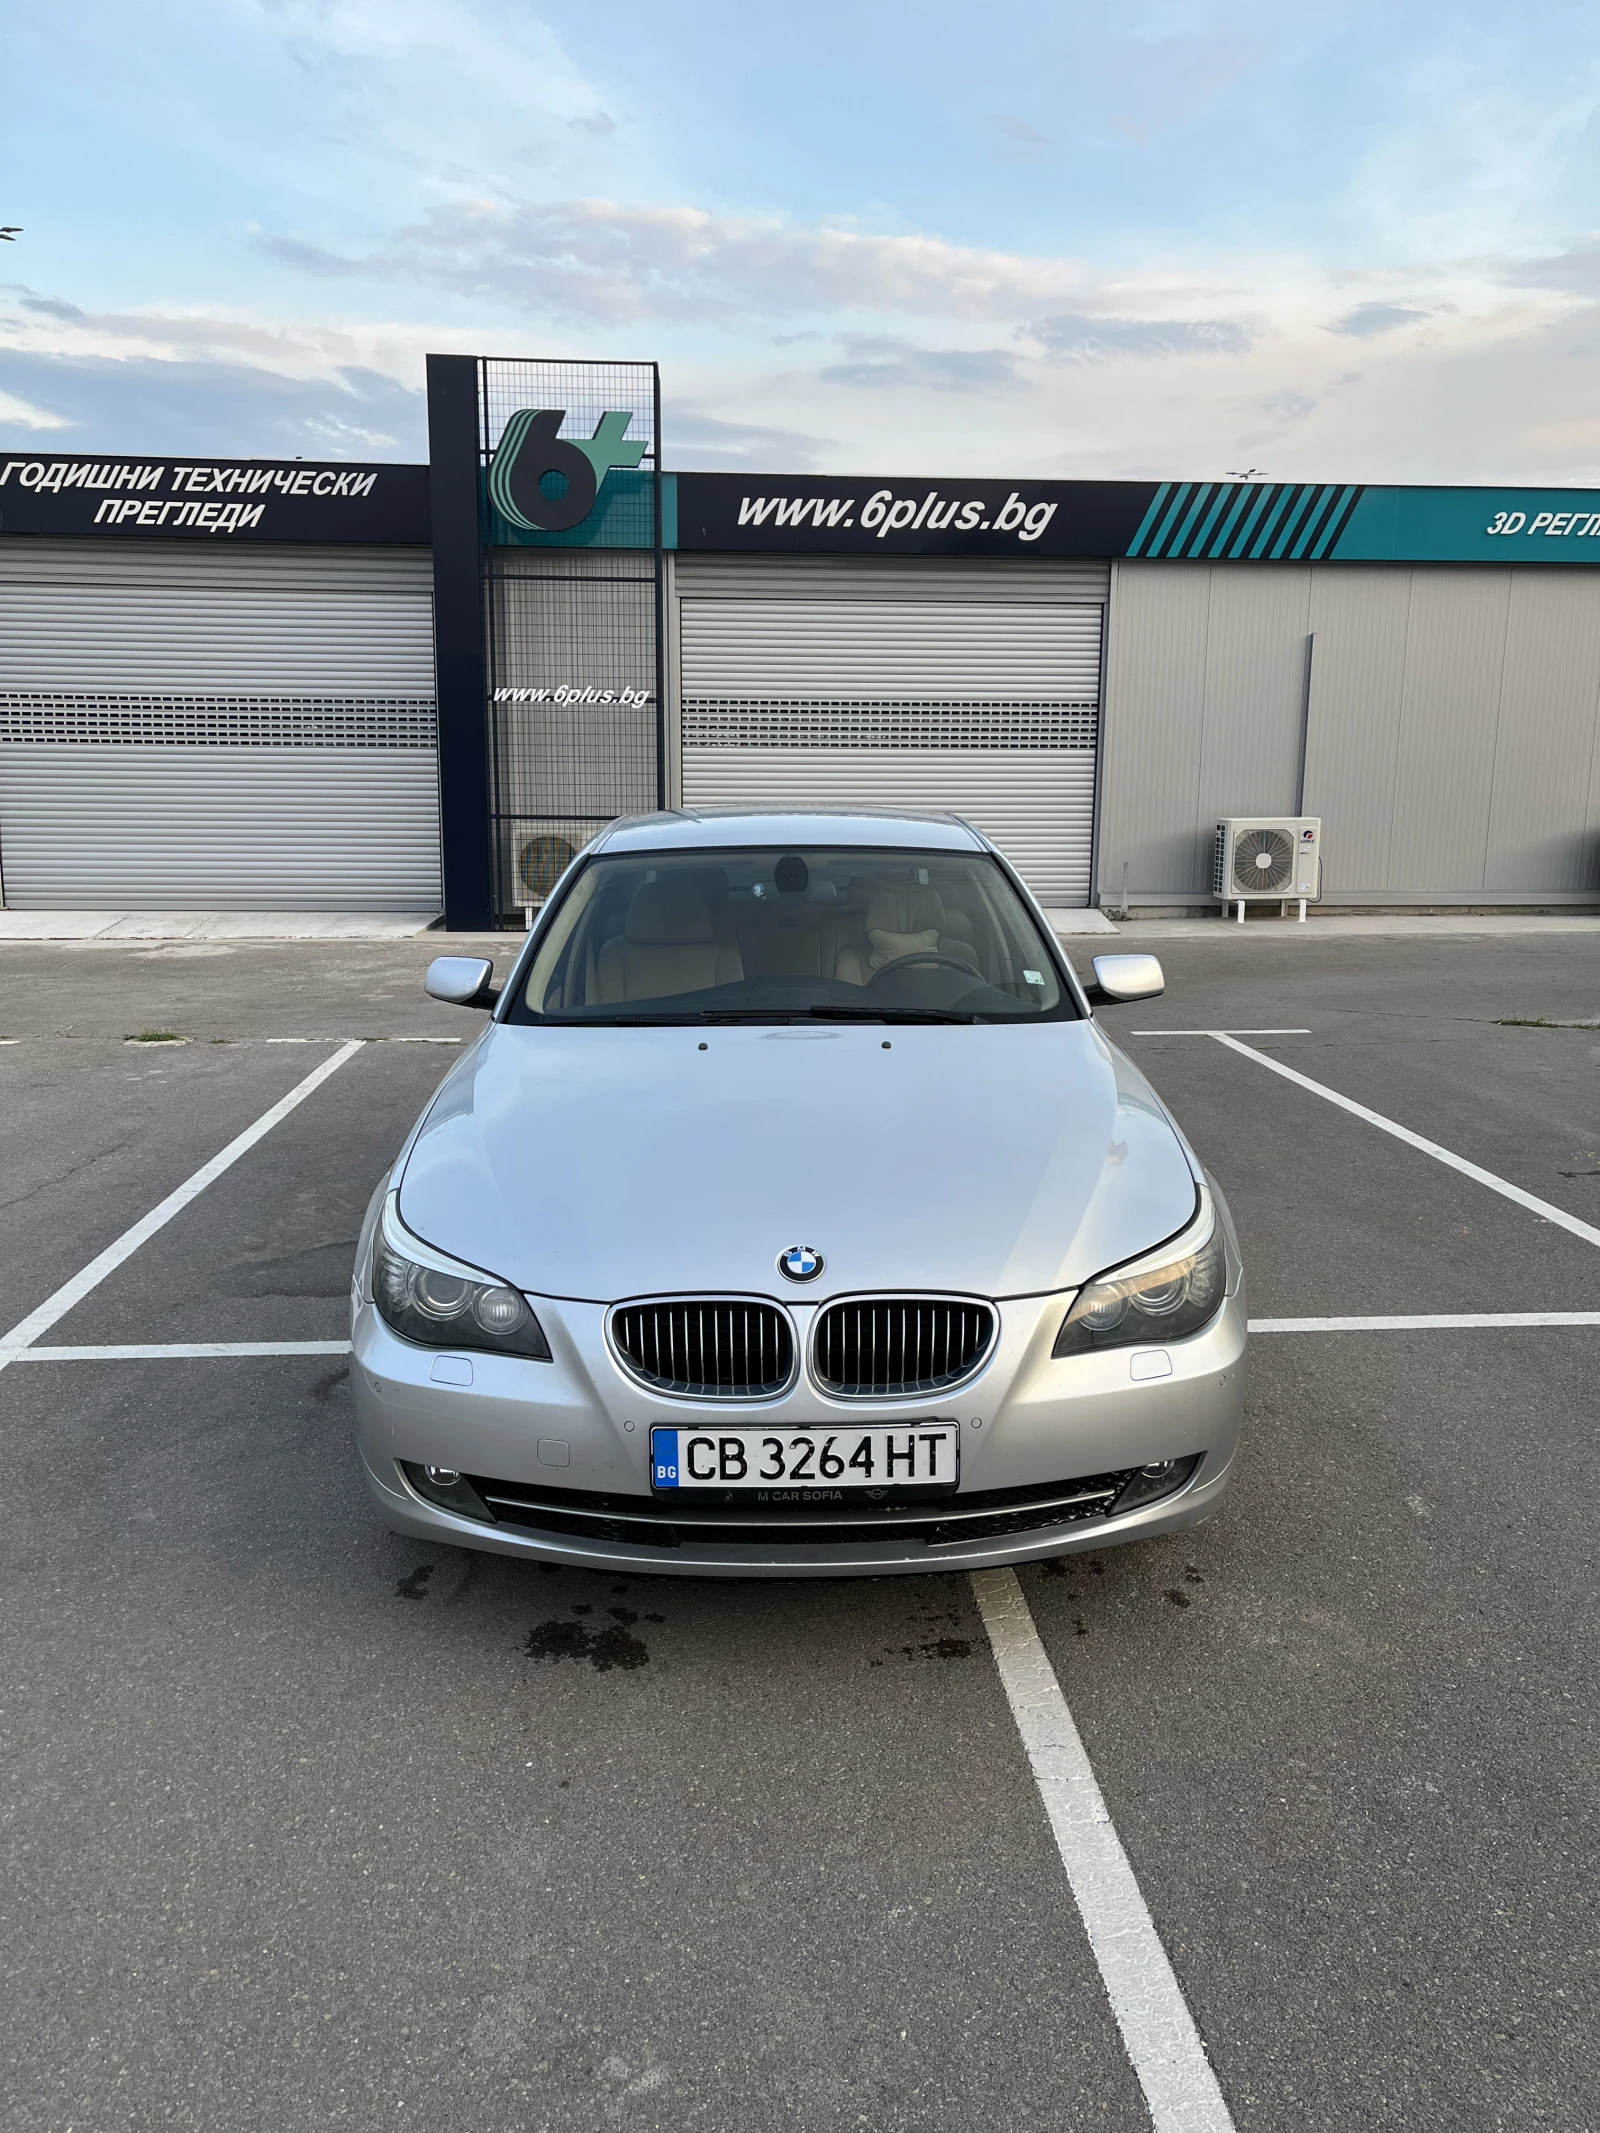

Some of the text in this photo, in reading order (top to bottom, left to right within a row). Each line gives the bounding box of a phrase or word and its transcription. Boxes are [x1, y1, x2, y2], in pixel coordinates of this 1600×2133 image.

[0, 461, 378, 497] ГОДИШНИ ТЕХНИЧЕСКИ
[94, 499, 265, 533] ПРЕГЛЕДИ
[737, 490, 1058, 541] www.6plus.bg
[1486, 512, 1600, 536] 3D РЕГЛ
[493, 684, 650, 709] www.6plus.bg
[783, 1246, 821, 1258] BMW
[687, 1433, 947, 1480] CB 3264 HT
[657, 1465, 677, 1479] BG
[758, 1490, 843, 1501] M CAR SOFIA
